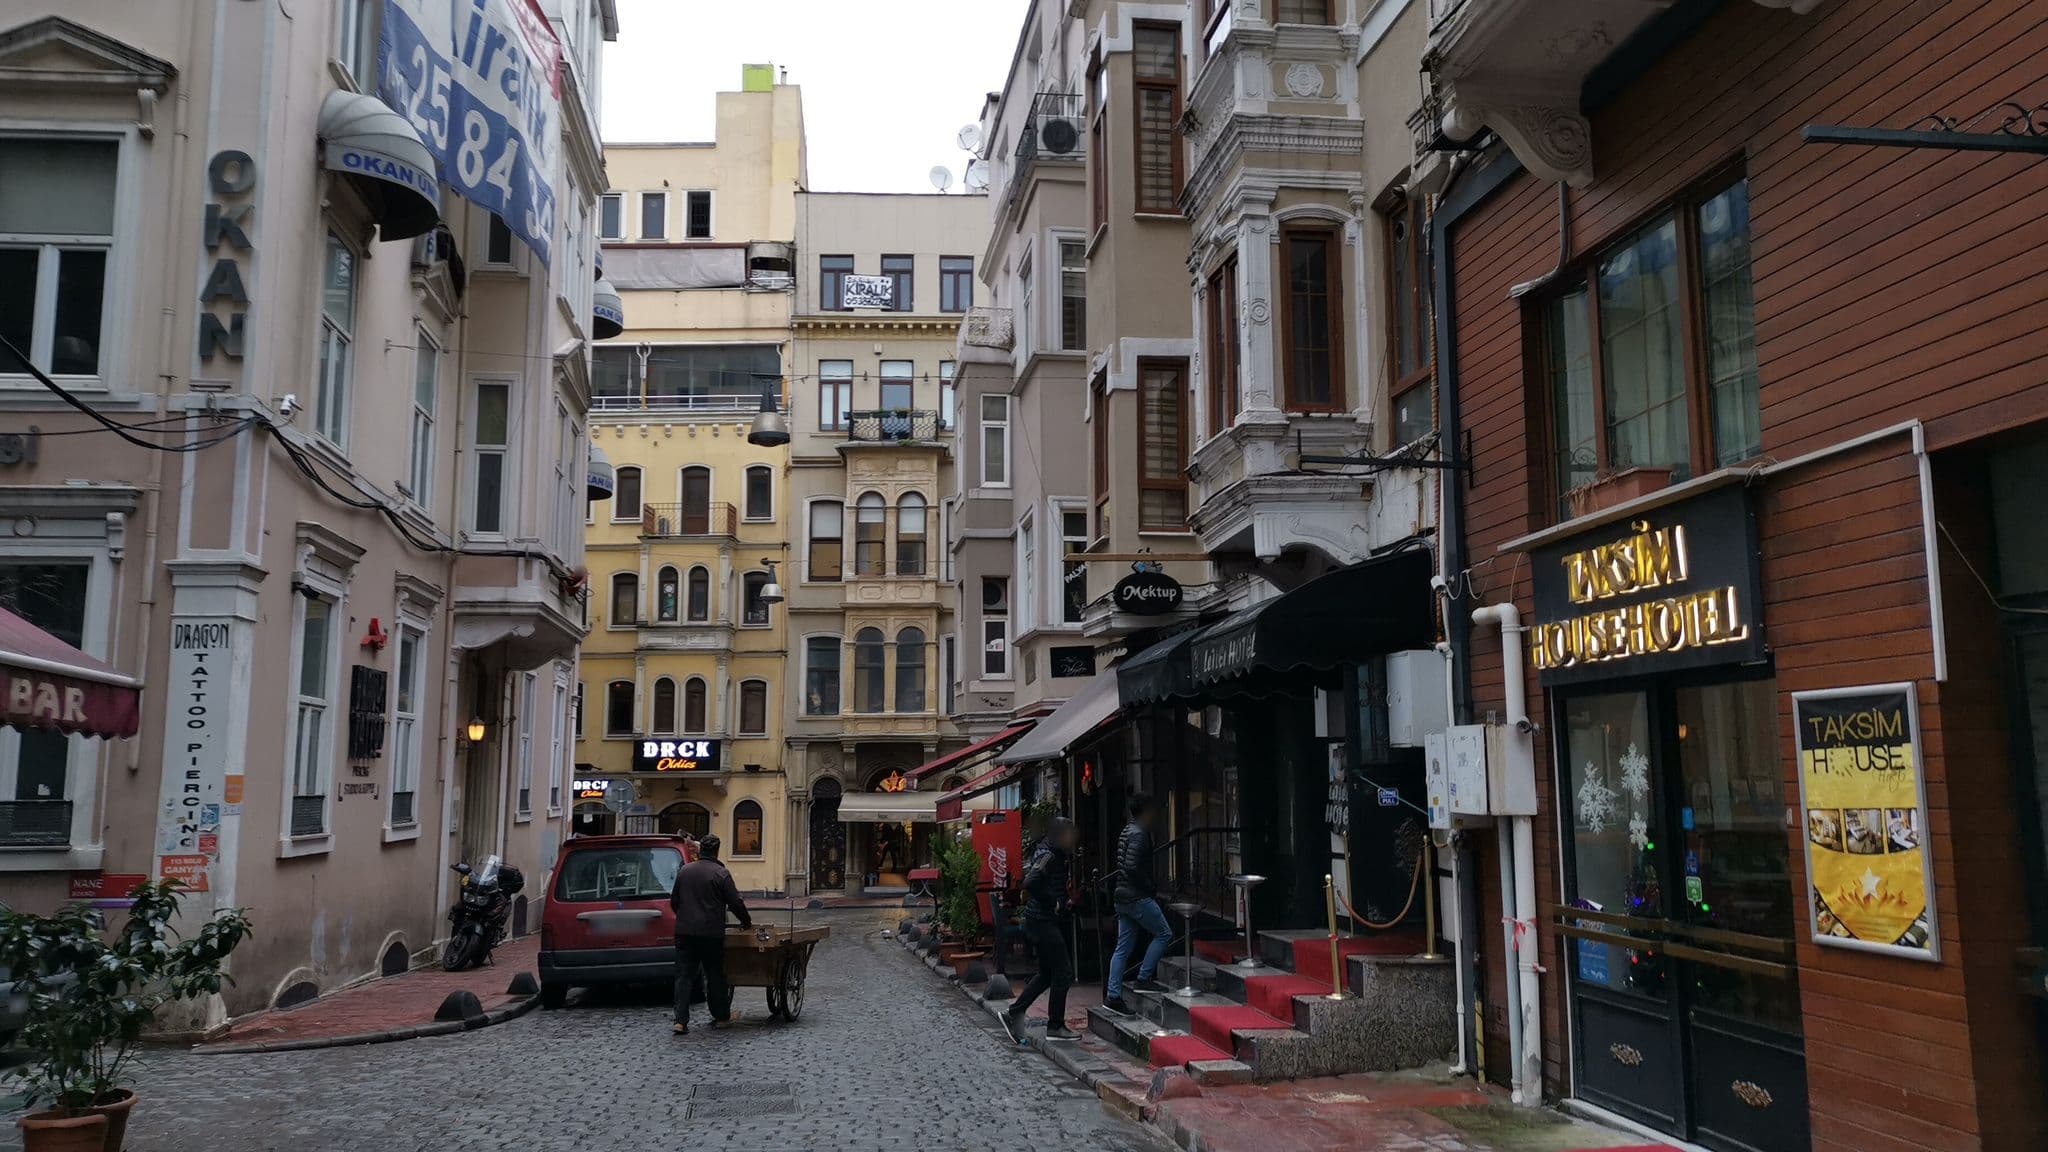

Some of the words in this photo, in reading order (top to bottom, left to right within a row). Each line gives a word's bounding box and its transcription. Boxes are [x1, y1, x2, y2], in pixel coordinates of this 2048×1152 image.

[343, 152, 413, 185] OKAN
[199, 150, 257, 361] OKAN
[1122, 585, 1177, 602] Mektup
[174, 623, 229, 650] DRAGON
[8, 677, 88, 722] BAR
[186, 653, 209, 729] TATTOO
[643, 741, 710, 758] DRCK
[656, 757, 697, 771] Oldies
